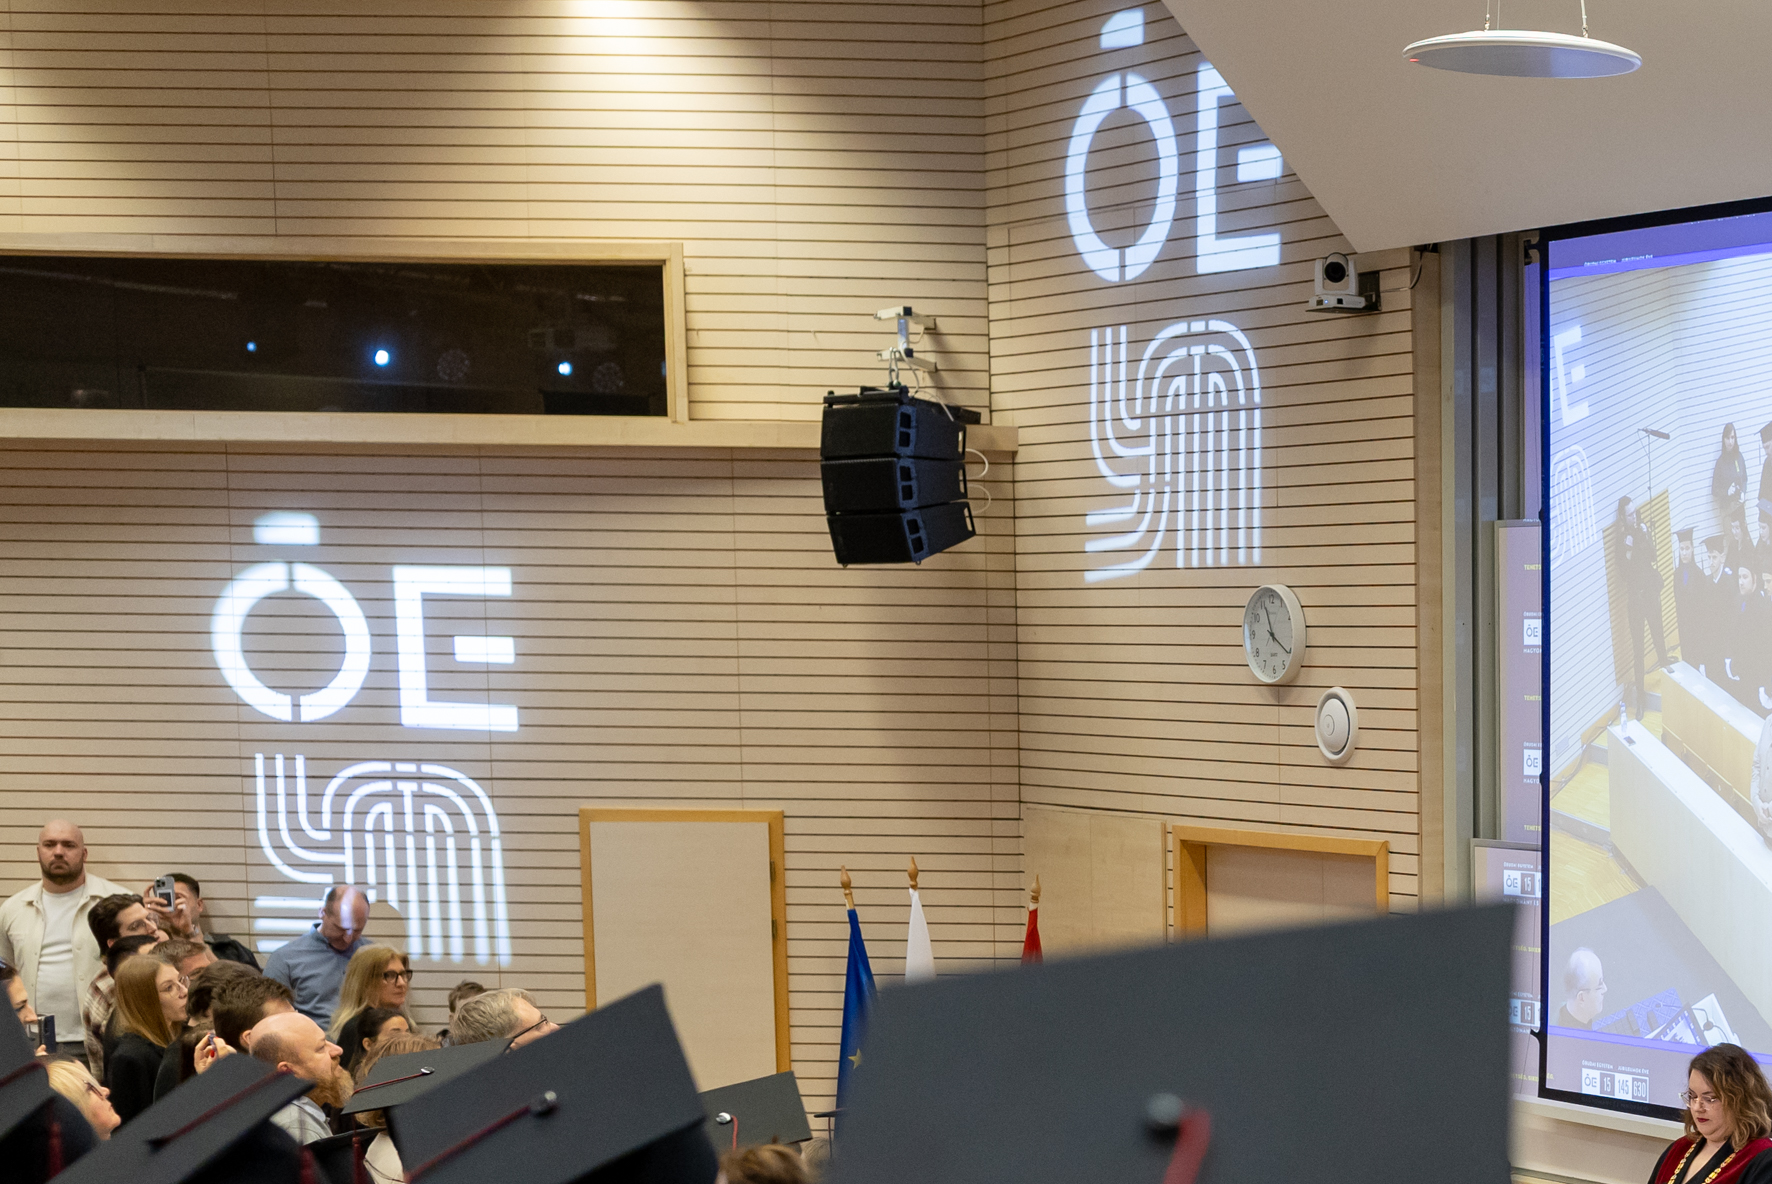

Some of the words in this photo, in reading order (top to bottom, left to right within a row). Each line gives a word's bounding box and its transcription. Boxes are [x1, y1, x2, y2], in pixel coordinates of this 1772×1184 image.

[1269, 594, 1275, 604] 12
[1524, 877, 1531, 891] 15
[1524, 1005, 1531, 1020] 15
[1584, 1073, 1597, 1088] ÓE
[1603, 1077, 1611, 1092] 15
[1618, 1079, 1630, 1095] 145
[1633, 1081, 1646, 1097] 630
